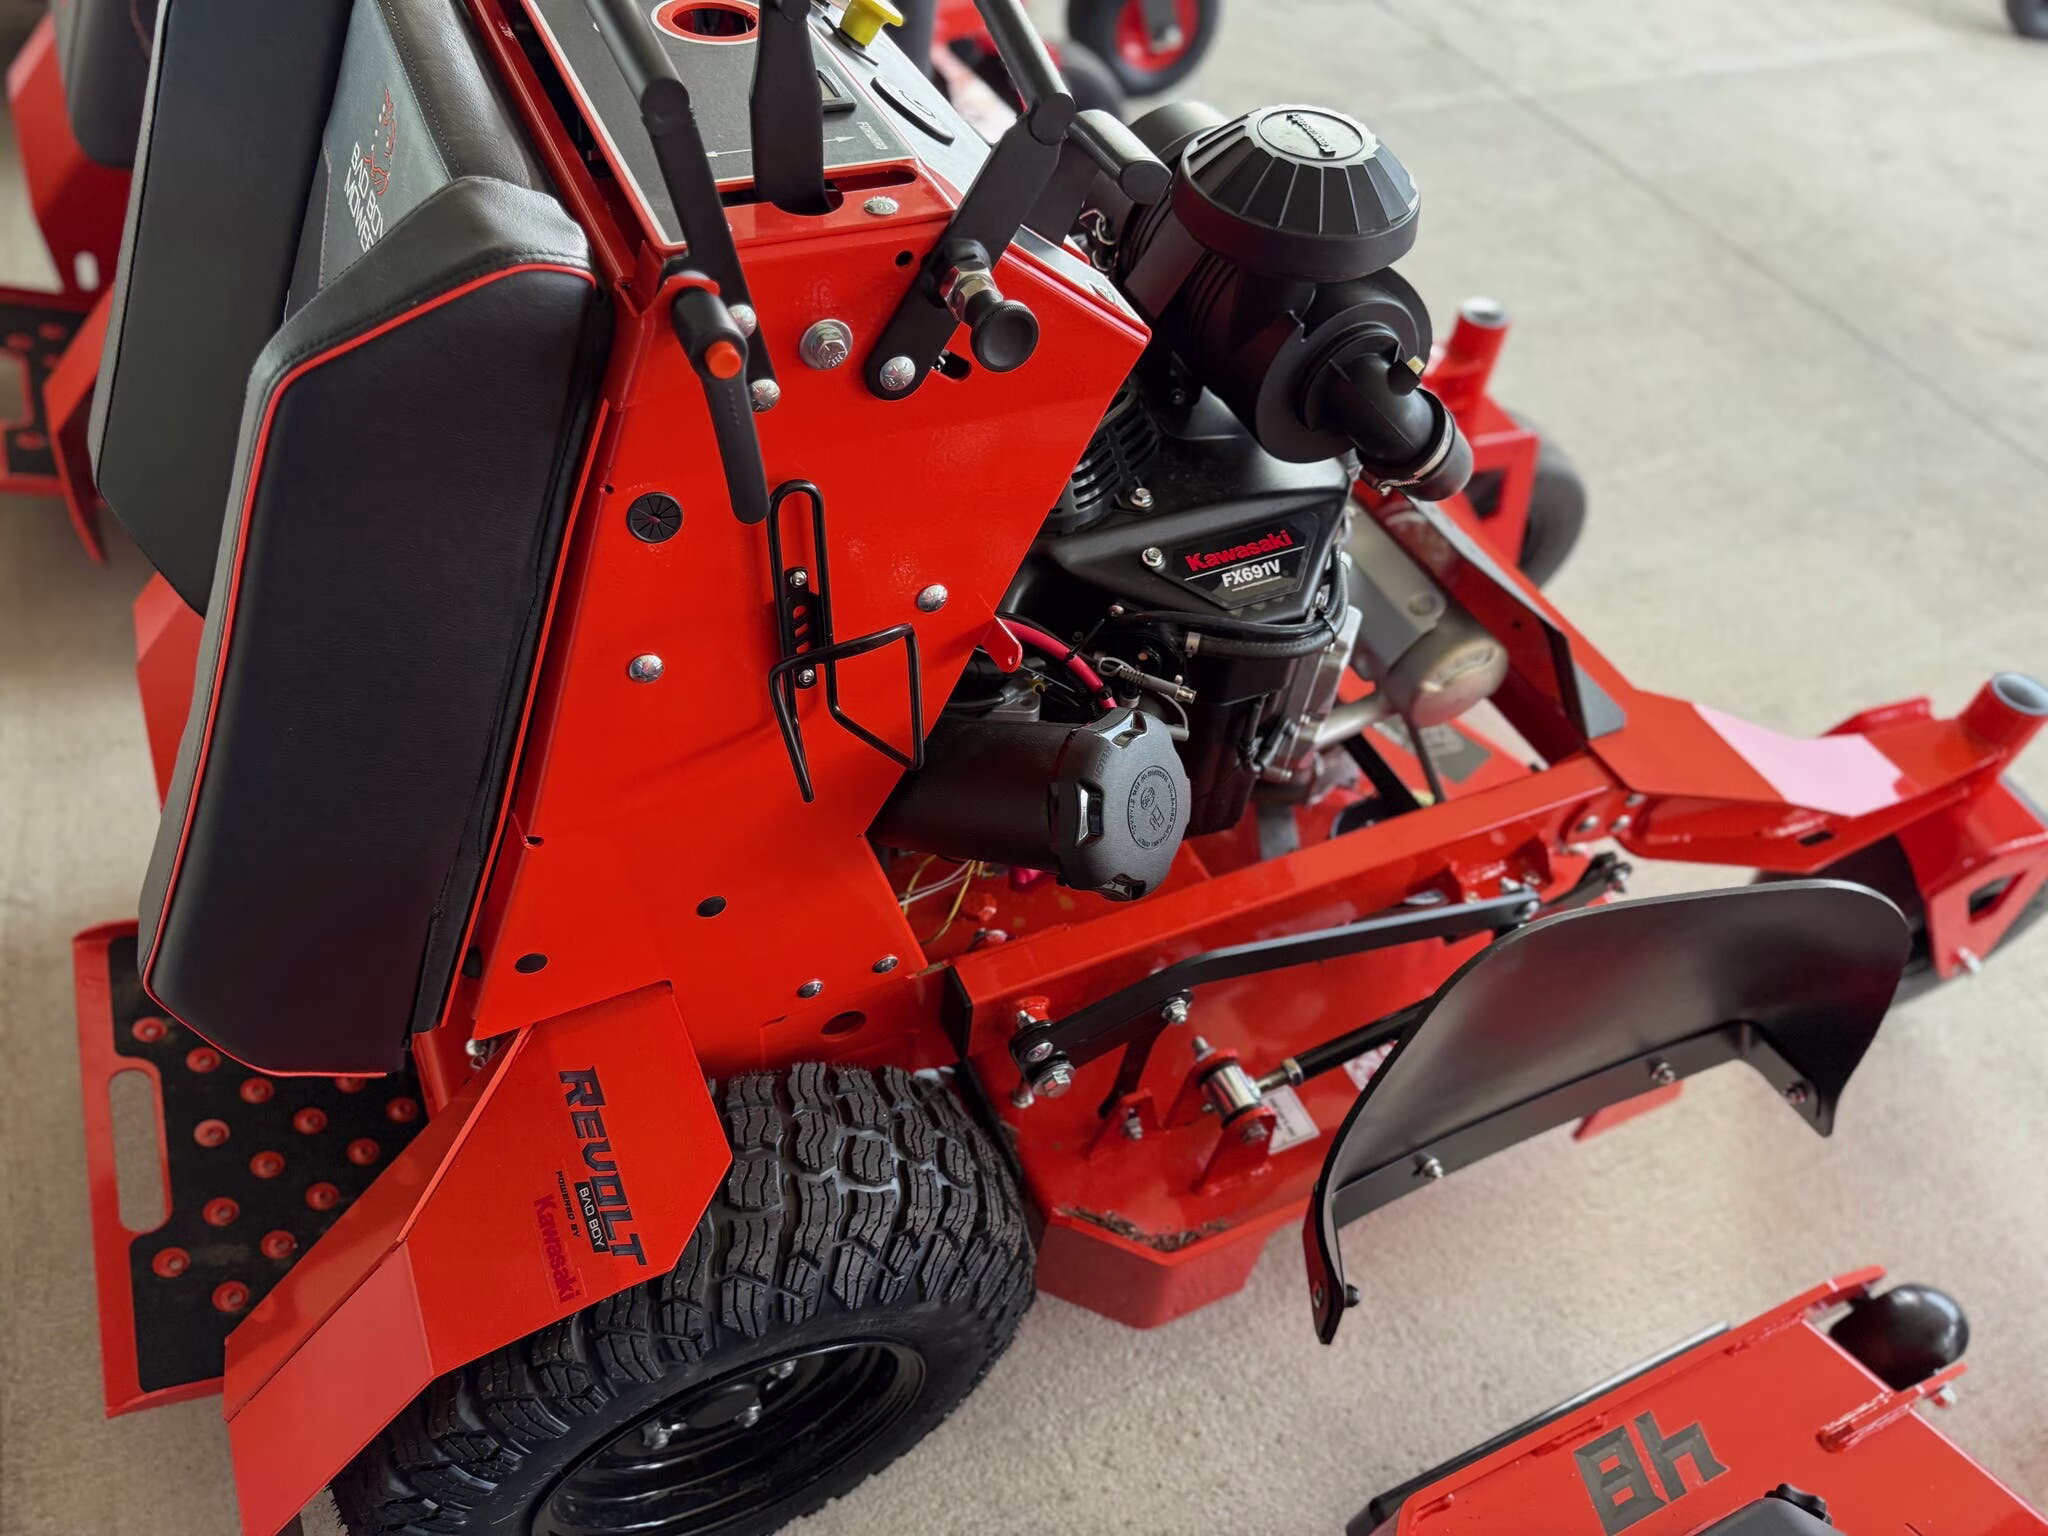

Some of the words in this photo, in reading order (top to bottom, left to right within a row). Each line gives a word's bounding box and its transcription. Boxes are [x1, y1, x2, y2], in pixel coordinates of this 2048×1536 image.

[351, 141, 369, 199] BAD
[1185, 529, 1294, 572] Kawasaki
[1221, 558, 1281, 588] FX691V
[558, 1064, 647, 1266] REVOLT
[555, 1170, 576, 1222] POWERED
[570, 1223, 581, 1238] BY
[578, 1186, 594, 1217] BAD
[587, 1217, 606, 1248] BOY
[534, 1194, 581, 1304] Kawasaki
[1573, 1411, 1729, 1536] 48
